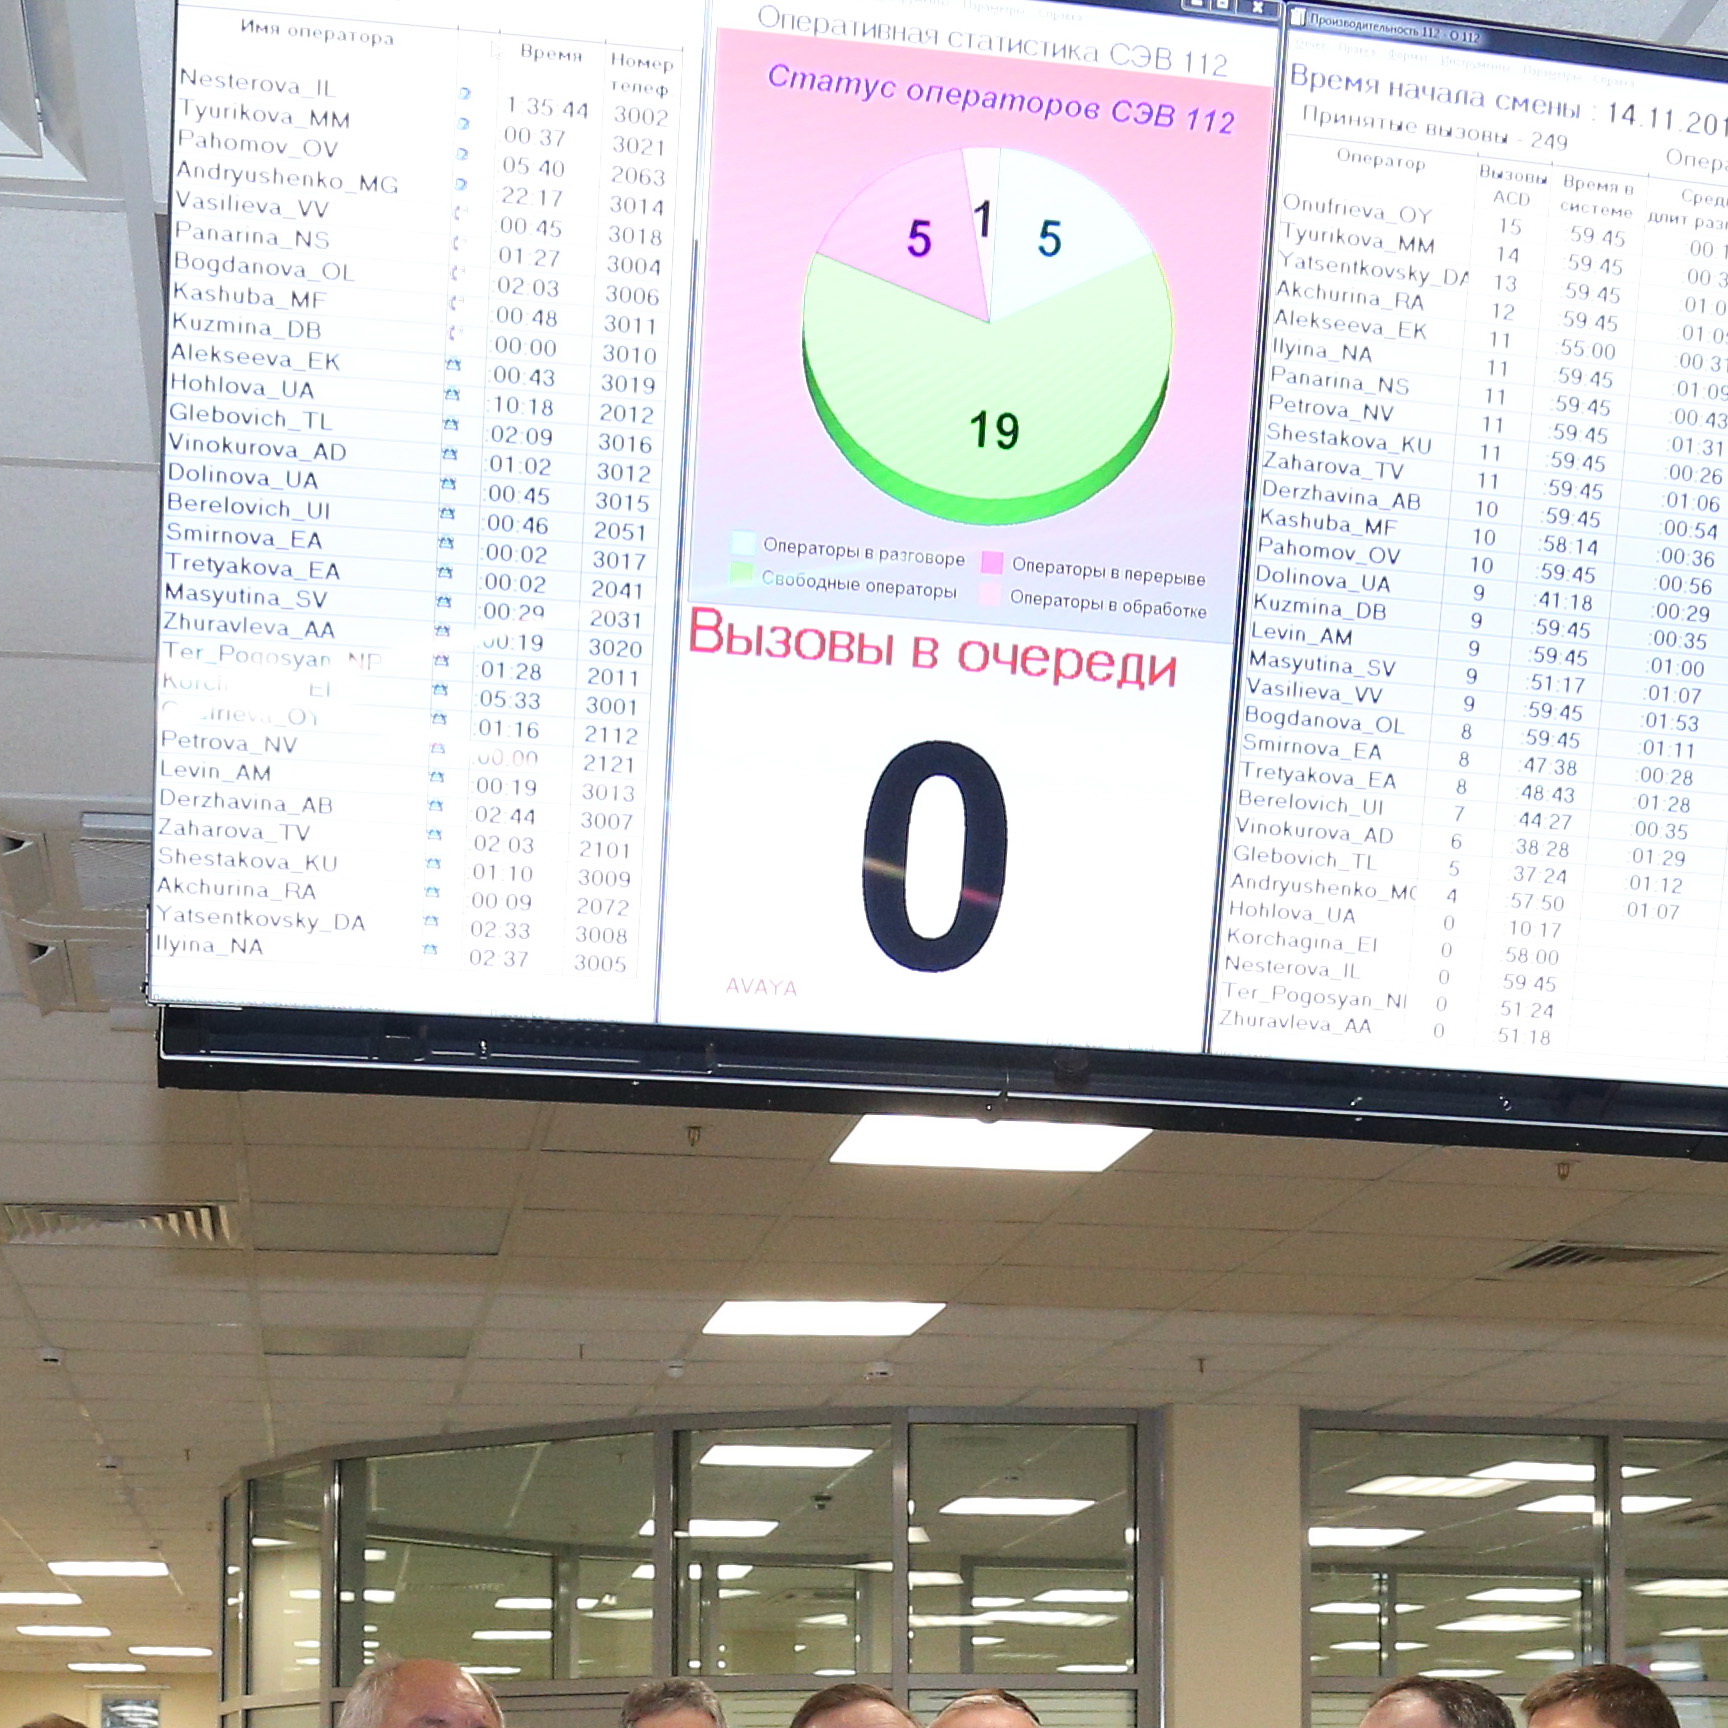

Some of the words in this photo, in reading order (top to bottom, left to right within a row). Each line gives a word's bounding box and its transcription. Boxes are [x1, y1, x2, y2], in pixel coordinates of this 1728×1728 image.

[240, 17, 280, 36] Имя
[287, 26, 394, 49] оператора
[757, 4, 939, 46] Оперативная
[947, 31, 1099, 63] статистика
[1109, 42, 1173, 71] СЭВ
[1185, 50, 1228, 78] 112
[520, 42, 583, 63] Время
[611, 51, 675, 75] Номер
[768, 62, 897, 103] Статус
[906, 82, 1101, 122] операторов
[1111, 98, 1176, 129] СЭВ
[1186, 106, 1235, 135] 112
[1290, 62, 1380, 95] Время
[1388, 80, 1485, 108] начала
[1495, 94, 1581, 120] смены
[178, 97, 350, 130] Tyurikova_MM
[612, 135, 664, 157] 3021
[613, 105, 669, 127] 3002
[1303, 103, 1418, 134] Принятые
[1425, 123, 1509, 145] вызовы
[1530, 131, 1568, 152] 249
[177, 127, 339, 160] Pahomov_OV
[610, 165, 666, 188] 2063
[1336, 147, 1426, 174] Оператор
[1479, 163, 1548, 185] Вызовы
[175, 158, 399, 195] Andryushenko_MG
[609, 195, 664, 217] 3014
[1493, 189, 1531, 207] ACD
[174, 188, 330, 220] Vasilieva_VV
[608, 224, 663, 247] 3018
[973, 199, 991, 238] 1
[174, 219, 330, 251] Panarina_NS
[606, 254, 661, 277] 3004
[906, 218, 933, 259] 5
[1037, 218, 1062, 258] 5
[1280, 220, 1435, 255] Tyurikova_MM
[173, 249, 356, 283] Bogdanova_OL
[605, 284, 660, 307] 3006
[1274, 274, 1425, 312] Akchurina_RA
[172, 280, 328, 311] Kashuba_MF
[603, 313, 655, 336] 3011
[1272, 308, 1427, 341] Alekseeva_EK
[171, 310, 322, 341] Kuzmina_DB
[602, 343, 657, 366] 3010
[1273, 336, 1373, 364] Ilyina_NA
[169, 340, 341, 373] Alekseeva_EK
[600, 373, 656, 396] 3019
[1270, 364, 1410, 396] Panarina_NS
[169, 370, 316, 401] Hohlova_UA
[599, 402, 655, 426] 2012
[1268, 393, 1395, 423] Petrova_NV
[168, 401, 334, 433] Glebovich_TL
[597, 432, 653, 455] 3016
[969, 409, 1020, 451] 19
[1266, 422, 1432, 456] Shestakova_KU
[167, 430, 347, 463] Vinokurova_AD
[596, 461, 652, 485] 3012
[1262, 450, 1405, 481] Zaharova_TV
[167, 460, 319, 492] Dolinova_UA
[595, 491, 650, 514] 3015
[1262, 478, 1421, 512] Derzhavina_AB
[166, 490, 330, 523] Berelovich_UI
[593, 520, 645, 543] 2051
[1260, 507, 1399, 538] Kashuba_MF
[164, 520, 323, 552] Smirnova_EA
[592, 549, 647, 572] 3017
[763, 535, 857, 562] Операторы
[864, 547, 875, 560] в
[875, 547, 966, 576] разговоре
[1258, 535, 1402, 567] Pahomov_OV
[163, 550, 341, 582] Tretyakova_EA
[591, 579, 642, 601] 2041
[761, 568, 861, 597] Свободные
[865, 580, 957, 603] операторы
[1012, 555, 1107, 582] Операторы
[1110, 567, 1120, 580] в
[1124, 568, 1207, 594] перерыве
[1253, 563, 1391, 594] Dolinova_UA
[164, 580, 329, 611] Masyutina_SV
[589, 609, 641, 630] 2031
[1010, 588, 1104, 614] Операторы
[1108, 599, 1118, 613] в
[1122, 598, 1208, 620] обработке
[1251, 592, 1387, 622] Kuzmina_DB
[162, 610, 336, 641] Zhuravleva_AA
[588, 637, 643, 659] 3020
[689, 605, 894, 667] Вызовы
[911, 636, 940, 670] в
[957, 640, 1177, 692] очереди
[1249, 620, 1353, 647] Levin_AM
[586, 666, 638, 688] 2011
[1246, 648, 1397, 679] Masyutina_SV
[585, 695, 636, 717] 3001
[1244, 673, 1384, 706] Vasilieva_VV
[584, 724, 639, 746] 2112
[1242, 700, 1406, 736] Bogdanova_OL
[160, 728, 299, 756] Petrova_NV
[583, 753, 633, 774] 2121
[1240, 733, 1382, 762] Smirnova_EA
[159, 758, 271, 784] Levin_AM
[581, 782, 635, 803] 3013
[1237, 759, 1397, 791] Tretyakova_EA
[159, 787, 333, 816] Derzhavina_AB
[580, 811, 634, 831] 3007
[1238, 788, 1384, 818] Berelovich_UI
[157, 816, 311, 844] Zaharova_TV
[579, 839, 629, 860] 2101
[1233, 812, 1394, 846] Vinokurova_AD
[157, 845, 338, 874] Shestakova_KU
[577, 868, 631, 888] 3009
[863, 740, 1008, 972] 0
[1233, 844, 1378, 872] Glebovich_TL
[155, 874, 317, 902] Akchurina_RA
[576, 897, 630, 917] 2072
[1229, 899, 1356, 925] Hohlova_UA
[155, 903, 367, 933] Yatsentkovsky_DA
[575, 925, 628, 945] 3008
[1227, 927, 1378, 955] Korchagina_EI
[155, 932, 264, 957] Ilyina_NA
[573, 953, 627, 974] 3005
[1224, 954, 1361, 981] Nesterova_IL
[725, 976, 797, 997] AVAYA
[1218, 1008, 1372, 1036] Zhuravleva_AA
